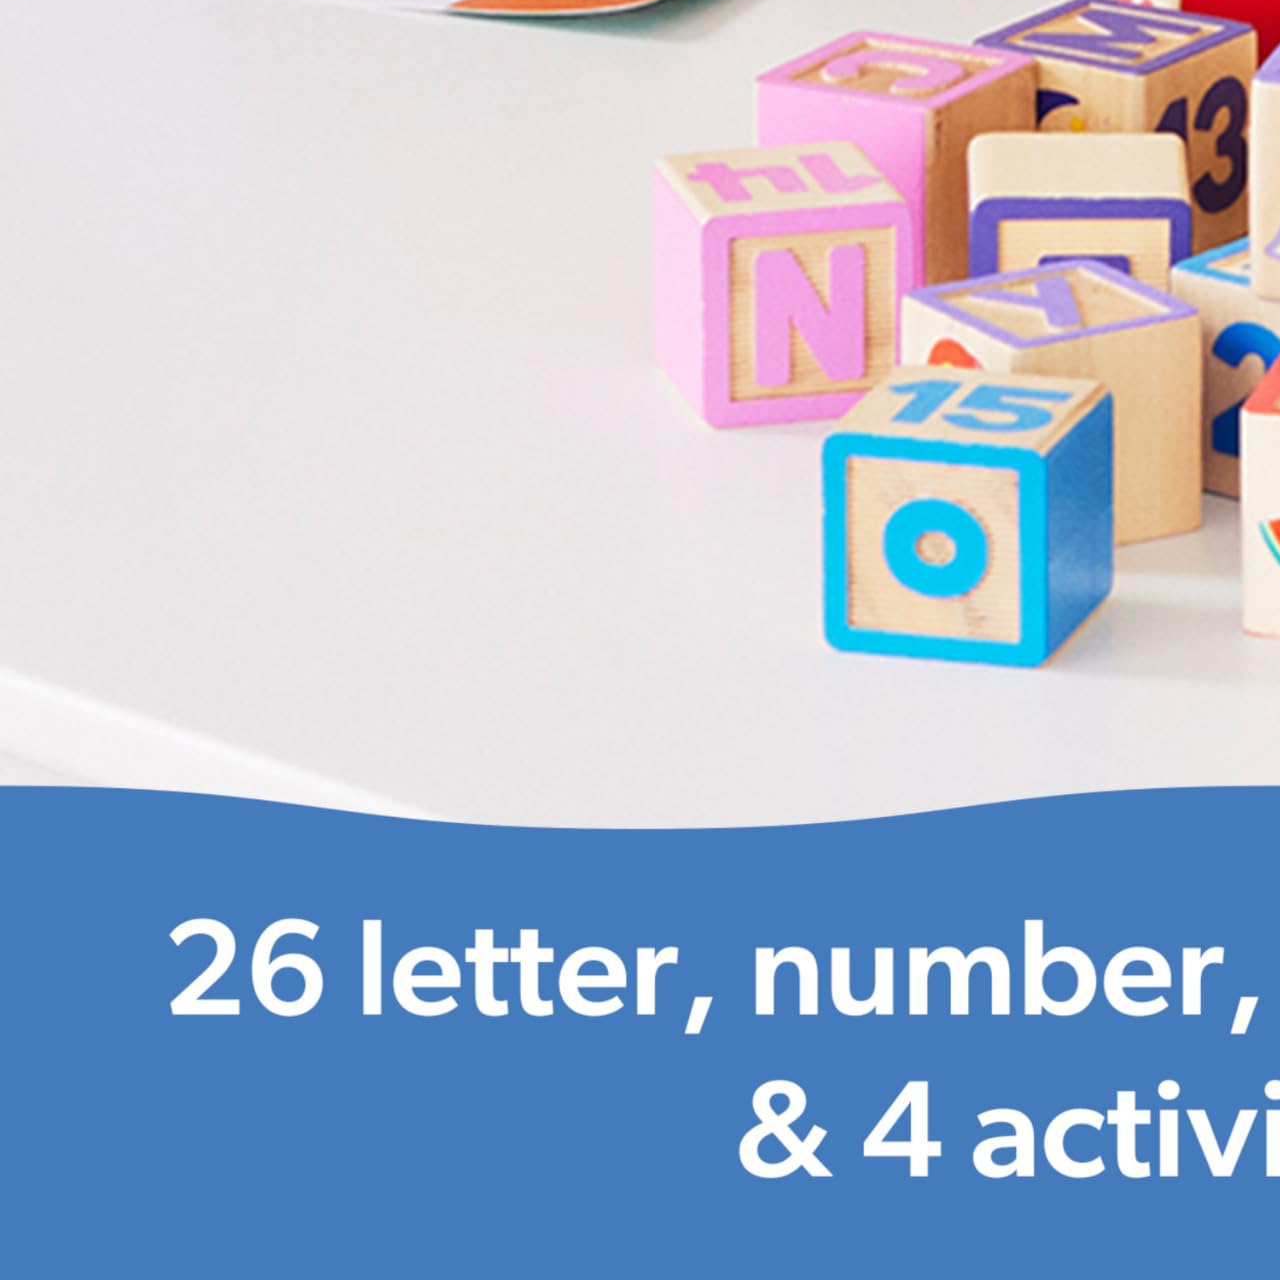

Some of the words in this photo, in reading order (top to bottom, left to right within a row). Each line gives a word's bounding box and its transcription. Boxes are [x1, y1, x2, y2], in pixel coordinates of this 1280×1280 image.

[1021, 9, 1204, 60] M
[687, 153, 884, 203] 14
[754, 244, 865, 387] N
[889, 380, 1074, 433] 15
[883, 497, 990, 599] O
